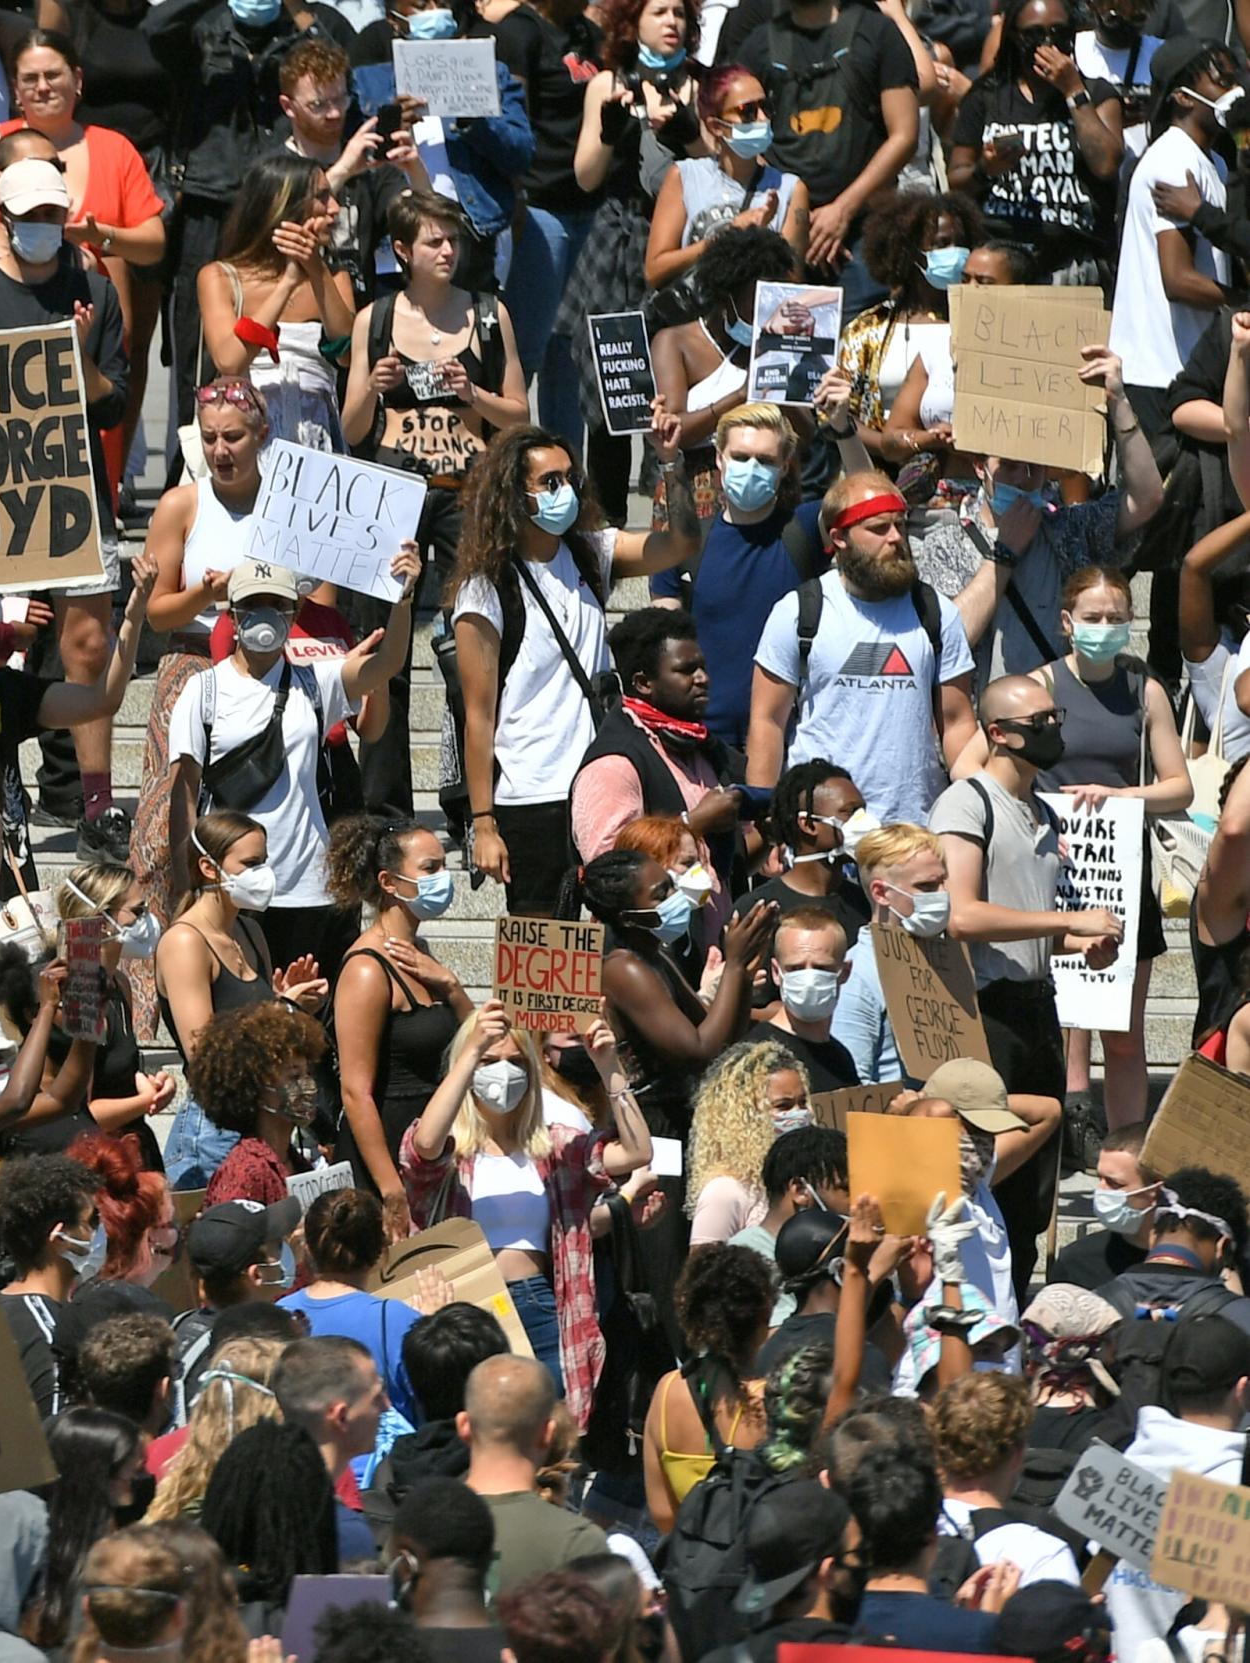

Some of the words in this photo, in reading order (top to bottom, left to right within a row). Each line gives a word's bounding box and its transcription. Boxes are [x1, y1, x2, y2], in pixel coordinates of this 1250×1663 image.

[1019, 151, 1074, 177] MAN
[973, 304, 1099, 351] BLACK
[599, 341, 633, 357] REALLY
[602, 358, 646, 374] FUCKING
[980, 361, 1075, 393] LIVES
[605, 377, 631, 391] HATE
[608, 393, 650, 409] RACISTS.
[402, 412, 461, 434] STOP
[972, 405, 1072, 444] MATTER
[394, 434, 478, 455] KILLING
[269, 451, 404, 528] BLACK
[262, 495, 384, 550] LIVES
[250, 526, 392, 597] MATTER
[833, 678, 918, 690] ATLANTA
[1059, 816, 1081, 835] OU
[1083, 818, 1117, 840] ARE
[1071, 843, 1116, 863] TRAL
[1062, 865, 1122, 882] TUATIONS
[1056, 885, 1124, 902] NJUSTICE
[498, 918, 549, 947] RAISE
[559, 926, 601, 953] THE
[496, 943, 602, 996] DEGREE
[910, 966, 937, 994] FOR
[1079, 973, 1116, 983] TUTU
[498, 989, 508, 1003] IT
[513, 991, 523, 1006] IS
[527, 992, 561, 1011] FIRST
[562, 997, 601, 1014] DEGREE
[515, 1010, 578, 1034] MURDER
[914, 1029, 961, 1062] FLOYD
[1115, 1466, 1166, 1507] BLAC
[1105, 1487, 1158, 1532] LIVE
[1083, 1503, 1155, 1560] MATTE
